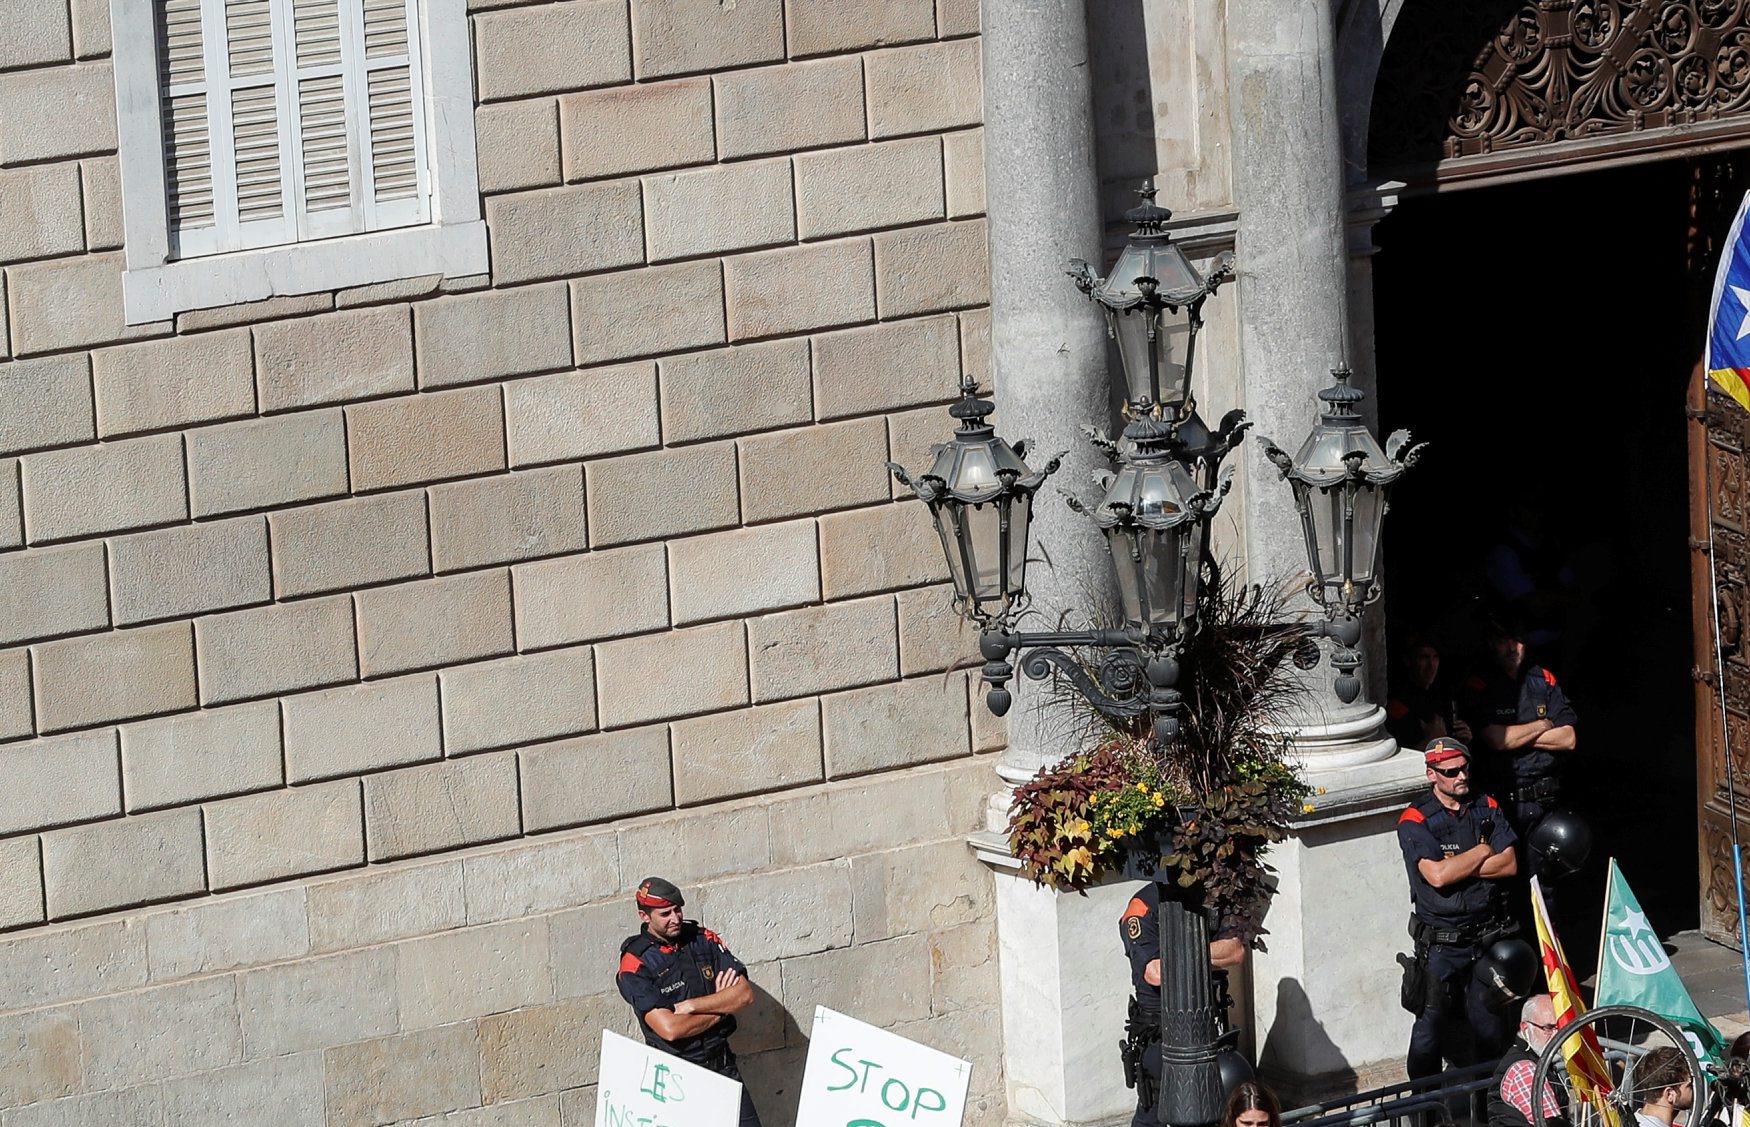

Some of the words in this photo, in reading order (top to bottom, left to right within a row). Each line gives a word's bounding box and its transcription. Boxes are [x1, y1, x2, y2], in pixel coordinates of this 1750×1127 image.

[1440, 843, 1460, 851] OLICIA
[660, 980, 685, 995] POLICIA
[640, 1055, 686, 1103] LES
[826, 1046, 946, 1120] STOP
